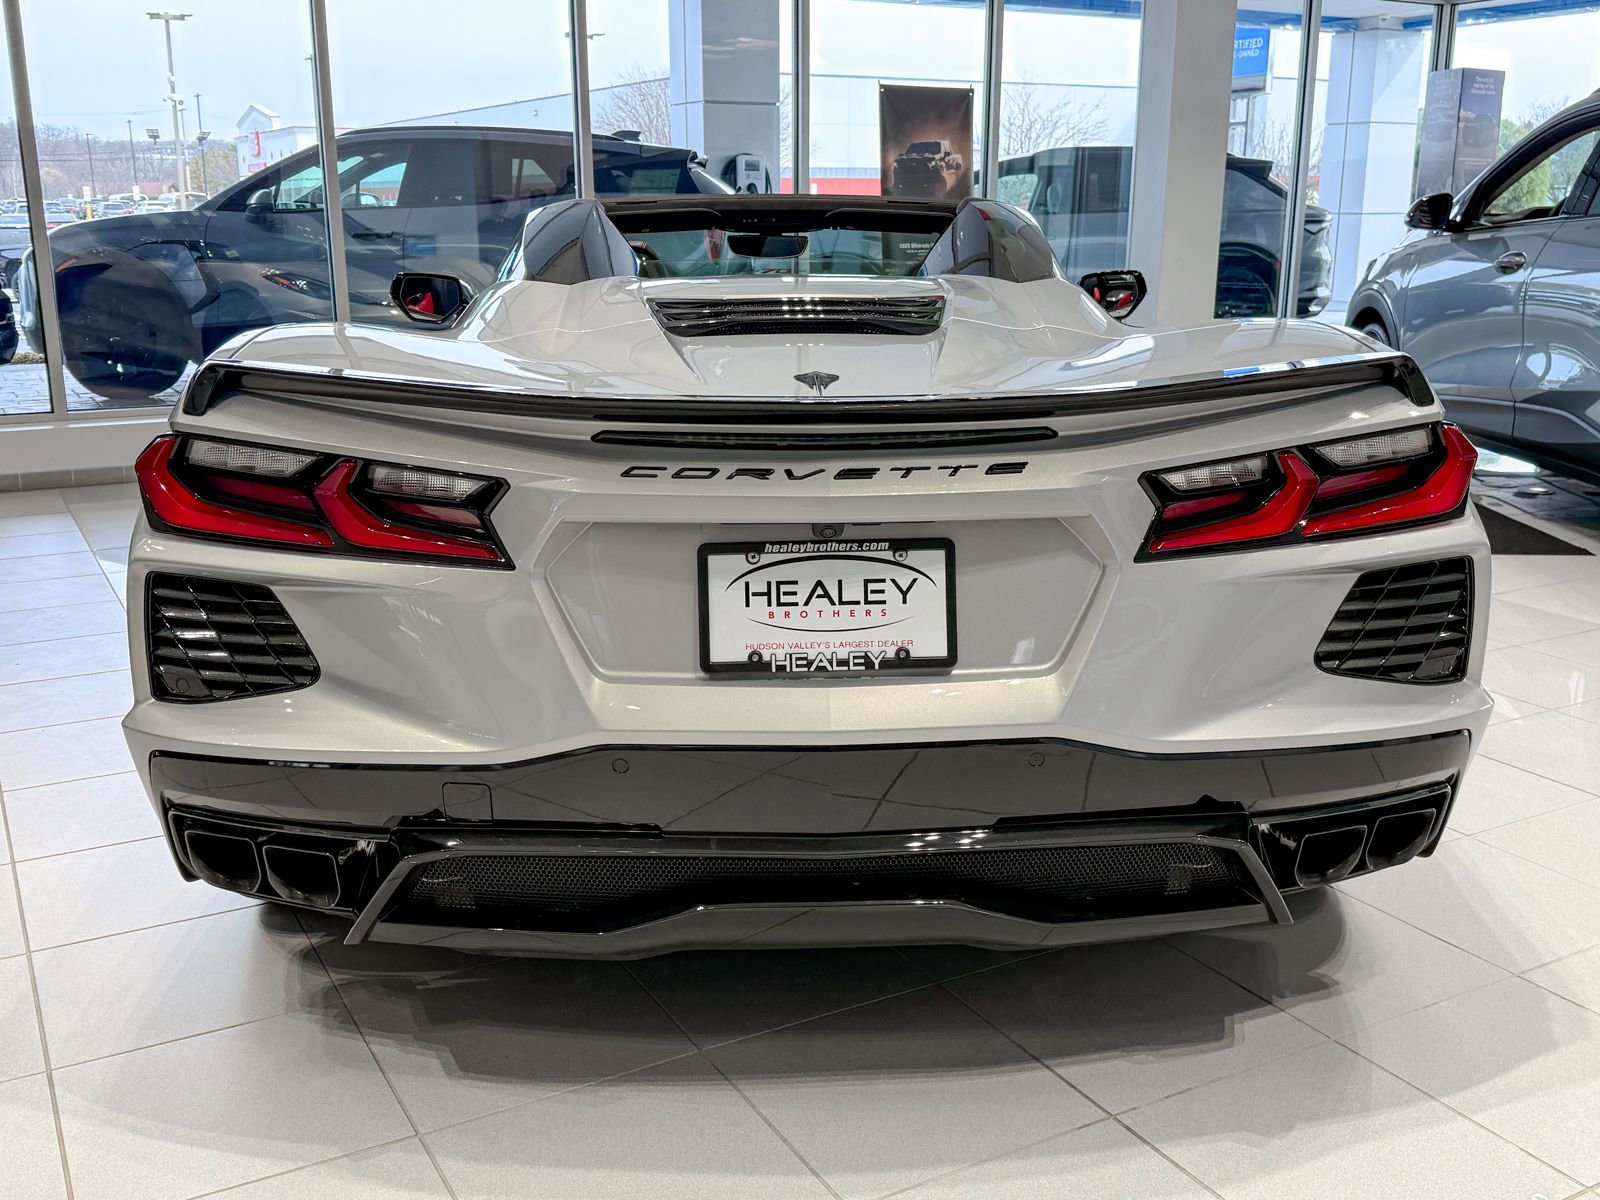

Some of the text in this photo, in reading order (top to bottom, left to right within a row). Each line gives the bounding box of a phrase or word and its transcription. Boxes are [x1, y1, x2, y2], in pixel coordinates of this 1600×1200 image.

[1234, 37, 1263, 49] RTIFIED
[620, 461, 1029, 480] CORVETTE
[764, 541, 889, 553] healeybrothers.com
[744, 577, 919, 608] HEALEY
[768, 608, 887, 620] BROTHERS
[745, 639, 914, 651] HUDSON VALLEY'S LARGEST DEALER
[770, 650, 887, 673] HEALEY
